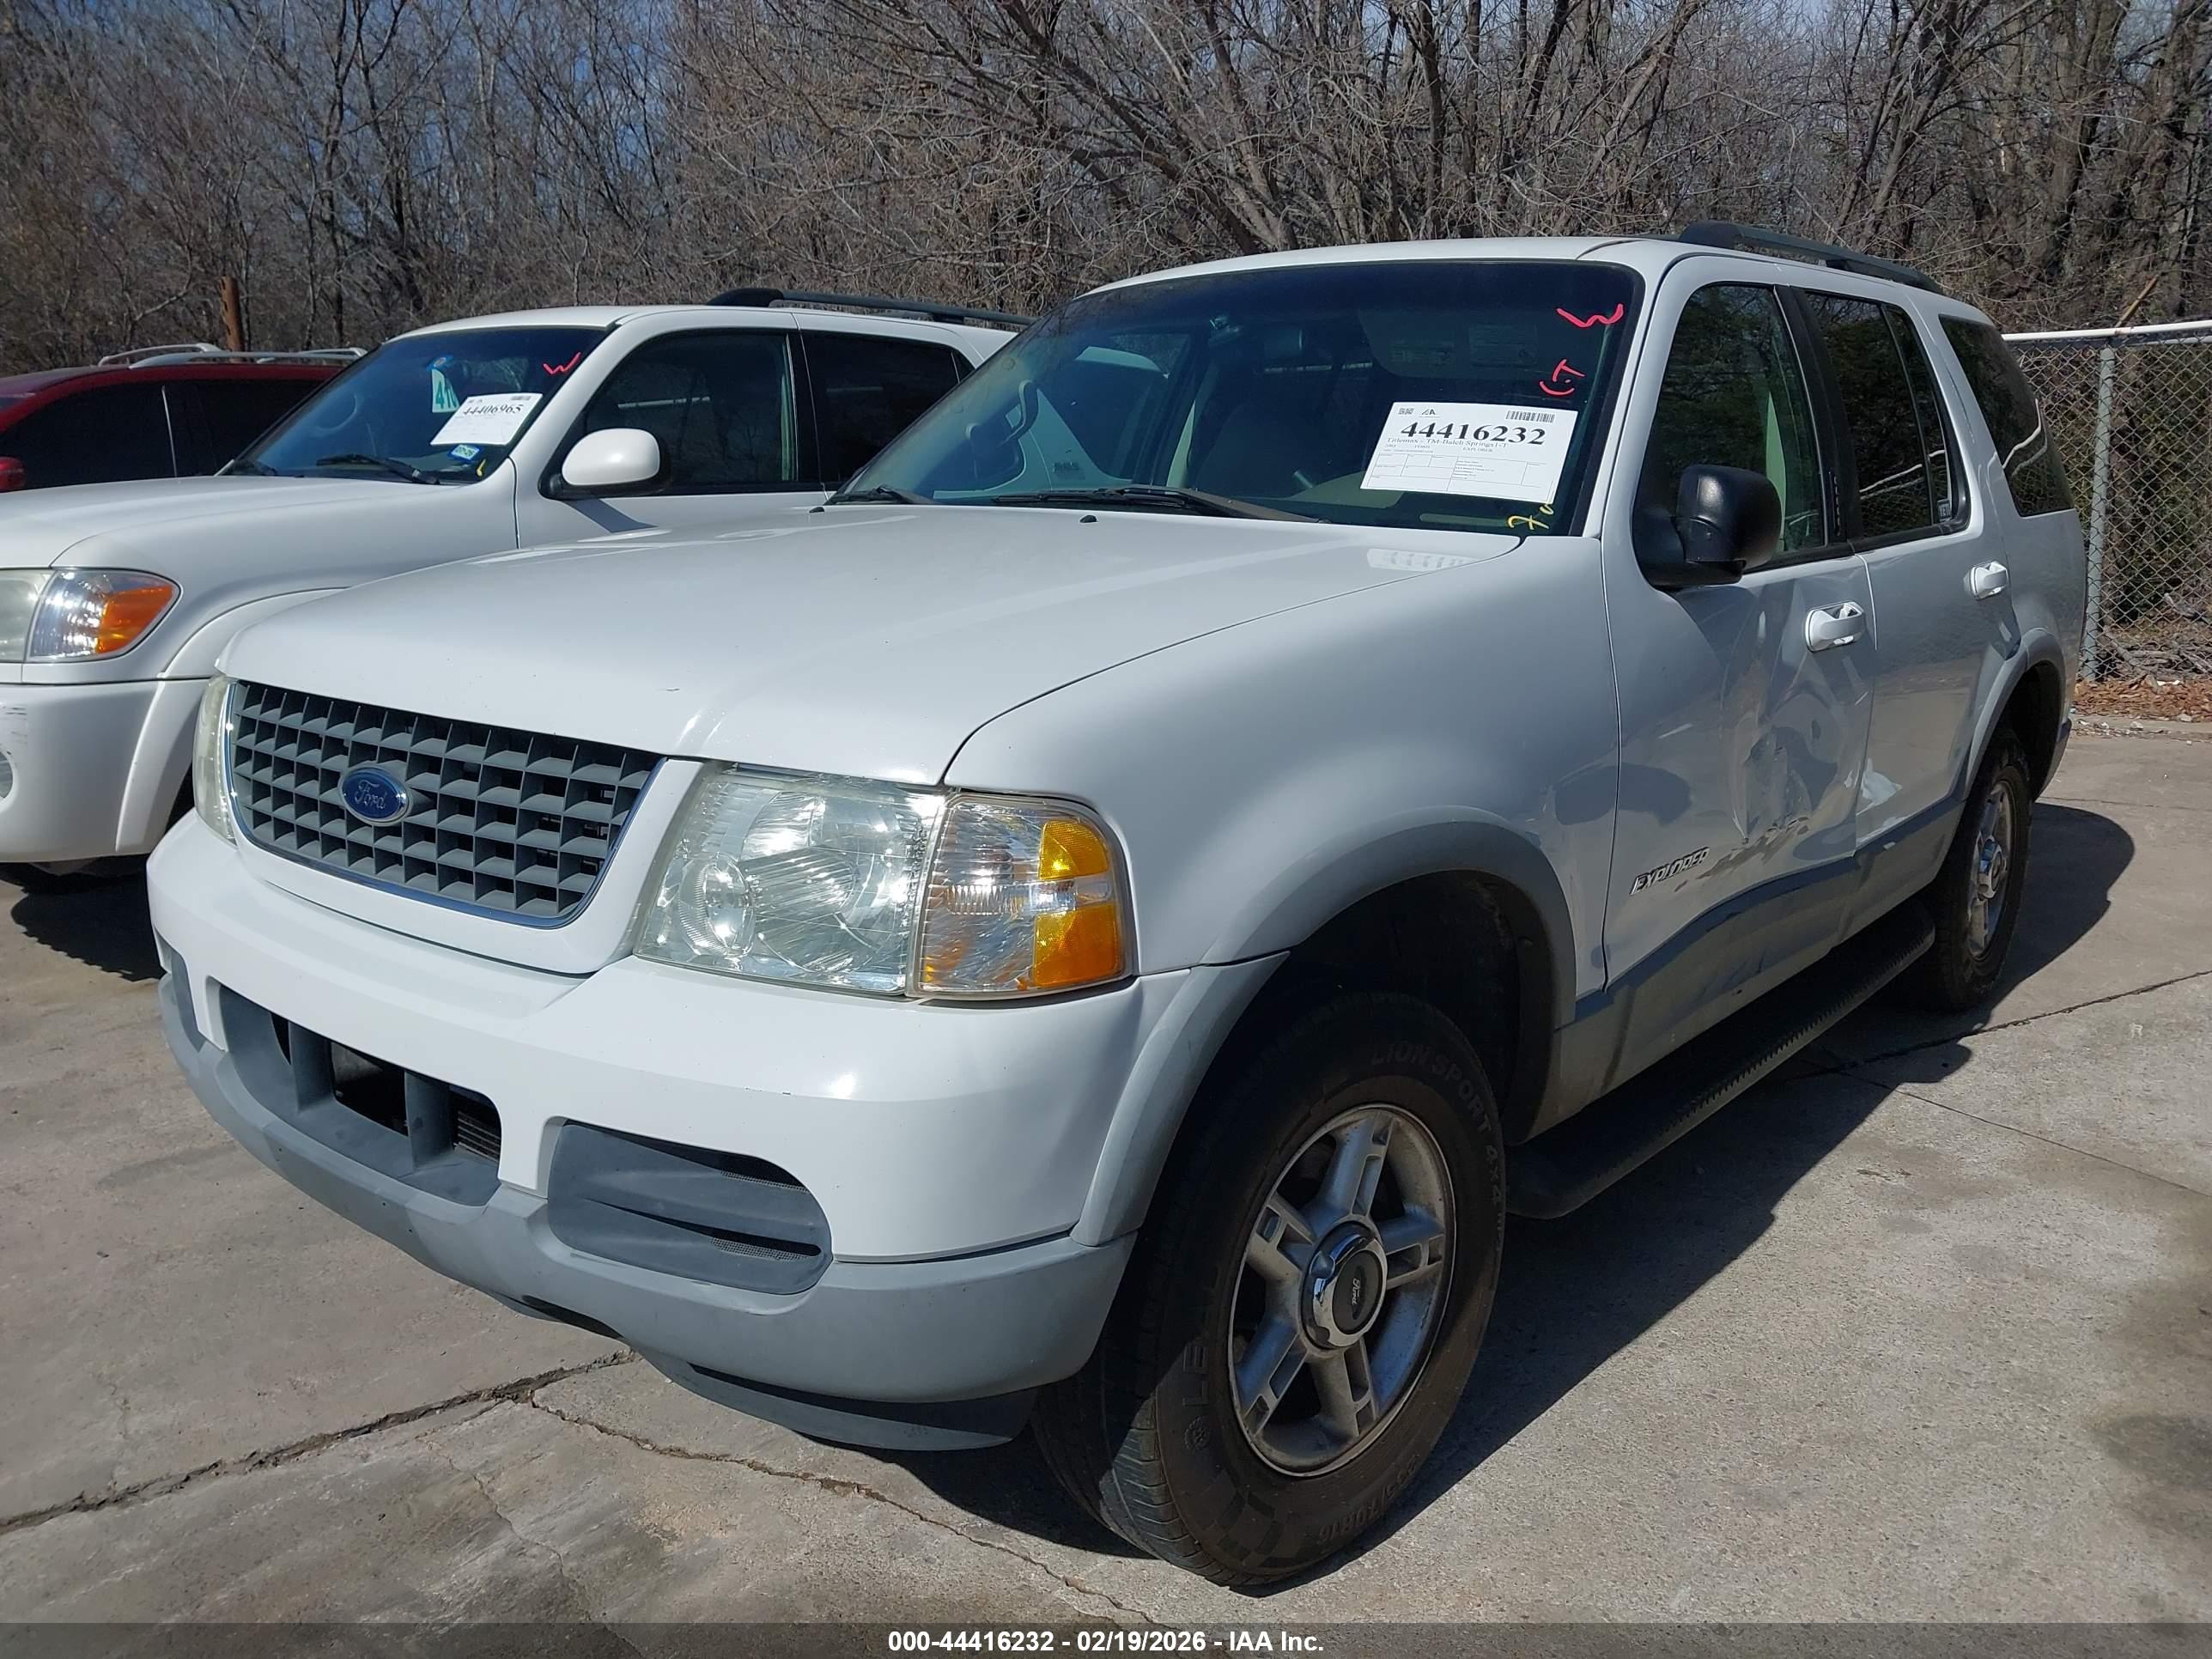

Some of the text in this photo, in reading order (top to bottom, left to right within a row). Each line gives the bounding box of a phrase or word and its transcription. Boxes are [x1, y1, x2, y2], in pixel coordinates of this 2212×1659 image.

[1401, 421, 1547, 446] 44416232
[354, 779, 389, 810] Ford
[1629, 847, 1711, 896] EXPLORER
